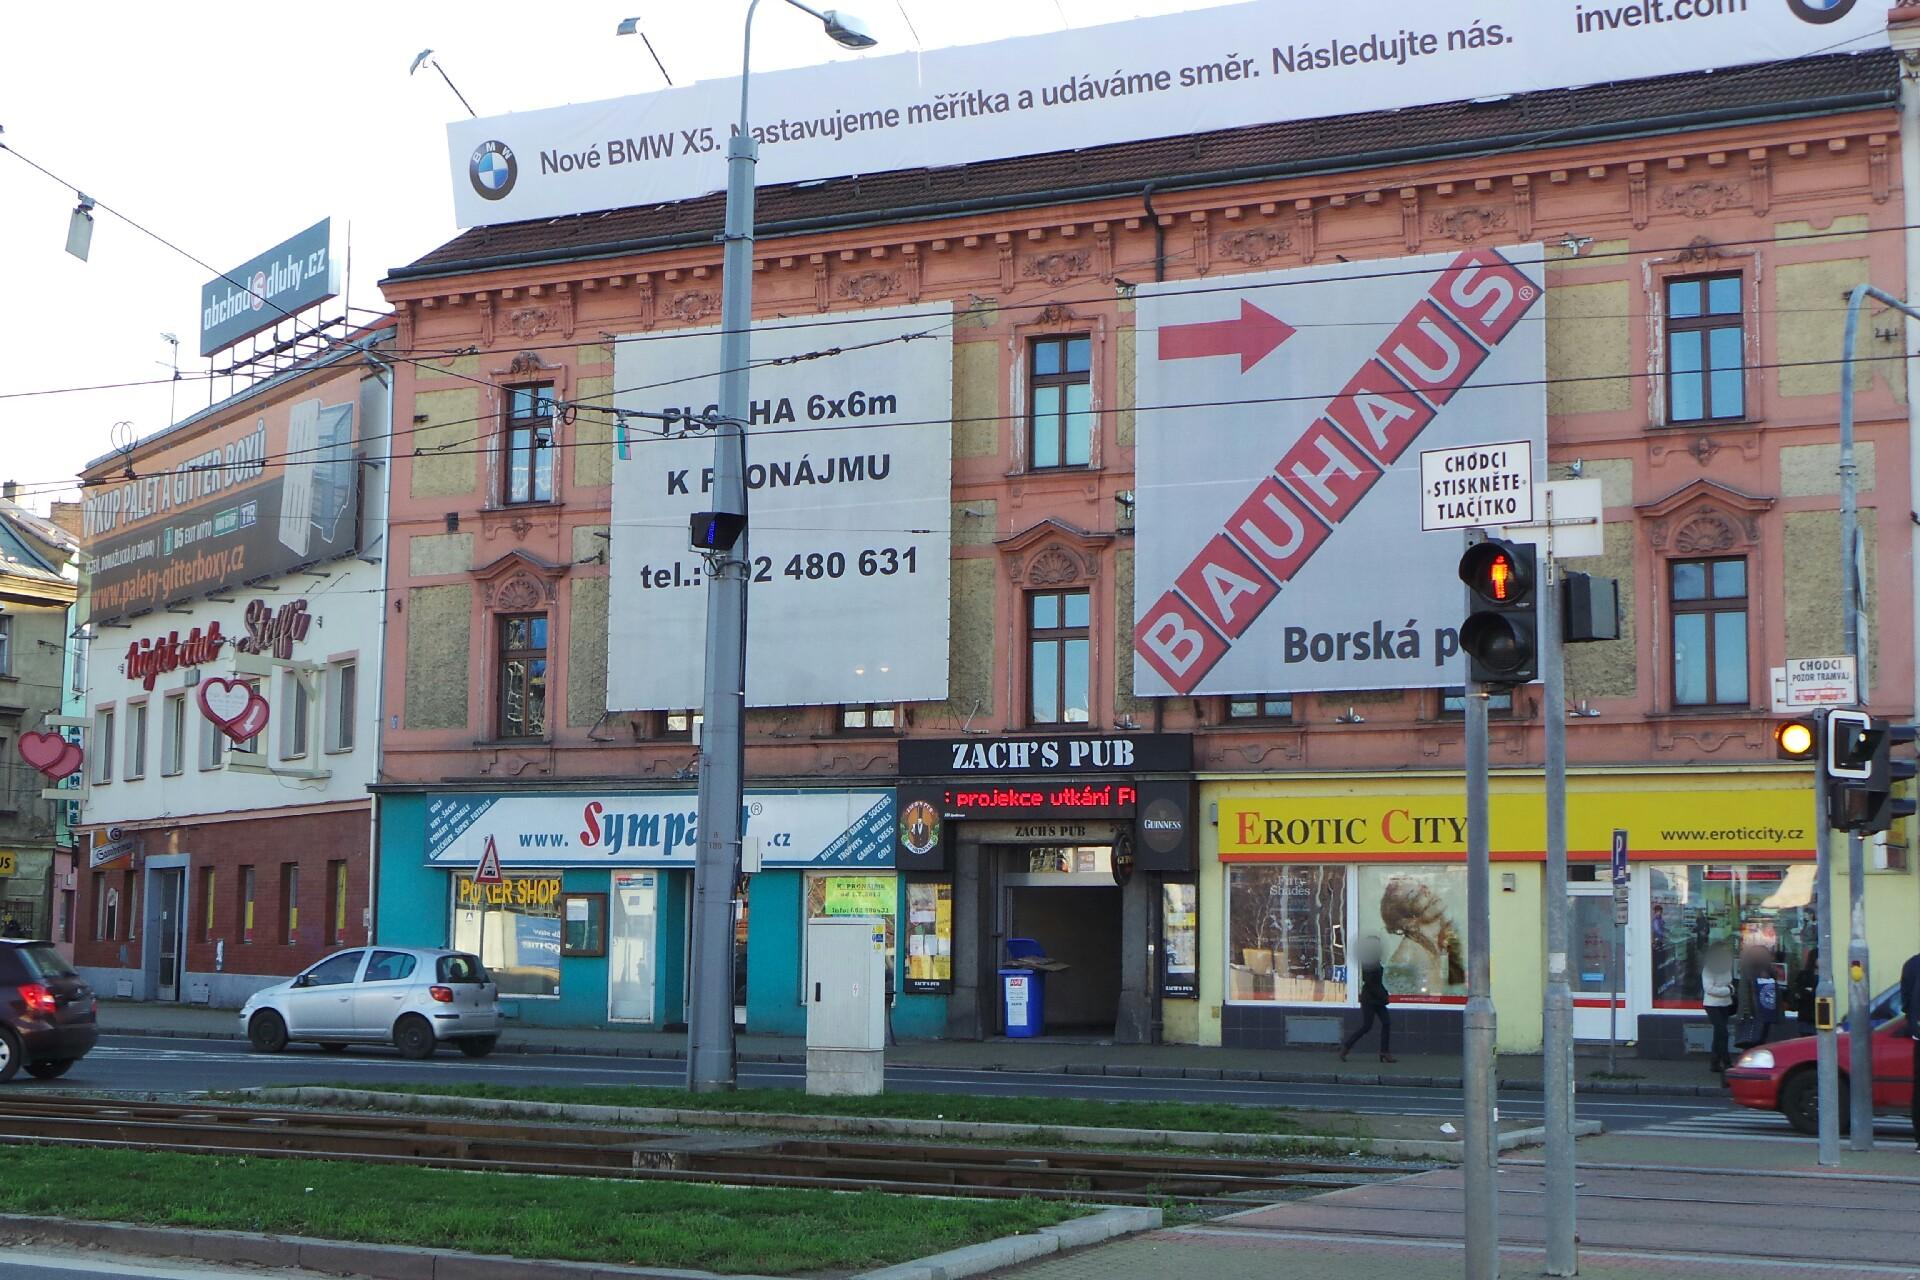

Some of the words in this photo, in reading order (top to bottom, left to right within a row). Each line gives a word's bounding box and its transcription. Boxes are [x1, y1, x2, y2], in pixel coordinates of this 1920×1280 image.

[1576, 0, 1746, 34] invelt.com
[540, 143, 601, 175] Nové
[607, 132, 674, 166] BMW
[681, 127, 721, 156] X5.
[732, 107, 900, 146] Nastavujeme
[907, 88, 1010, 122] měřítka
[1017, 89, 1034, 110] a
[1042, 68, 1171, 107] udáváme
[1179, 53, 1260, 87] směr.
[1272, 27, 1438, 76] Následujte
[1448, 18, 1514, 53] nás.
[473, 141, 513, 164] BMW
[807, 390, 898, 420] 6x6m
[1142, 259, 1516, 679] BAUHAUS
[1445, 451, 1507, 473] CHODCI
[83, 488, 121, 540] VÝKUP
[122, 475, 160, 525] PALET
[173, 446, 222, 506] GITTER
[223, 416, 266, 489] BOXŮ
[667, 469, 689, 496] K
[1433, 471, 1520, 497] STISKNĚTE
[1437, 495, 1517, 520] TLAČÍTKO
[92, 544, 245, 612] www.palety-gitterboxy.cz
[641, 560, 701, 589] tel.:
[785, 551, 845, 581] 480
[858, 546, 917, 577] 631
[1284, 619, 1420, 665] Borská
[1792, 673, 1815, 682] POZOR
[1817, 671, 1849, 681] TRAMVAJ
[1799, 659, 1841, 671] CHODCI
[952, 740, 1059, 769] ZACH'S
[1069, 739, 1135, 767] PUB
[957, 788, 1043, 807] projekce
[1050, 785, 1111, 806] utkání
[869, 812, 892, 834] MEDALS
[1060, 824, 1086, 836] PUB
[1144, 819, 1182, 829] GUINNESS
[1235, 811, 1367, 845] EROTIC
[1661, 826, 1804, 843] www.eroticcity.cz
[519, 833, 569, 847] www.
[877, 843, 892, 860] GOLF
[517, 879, 560, 904] SHOP
